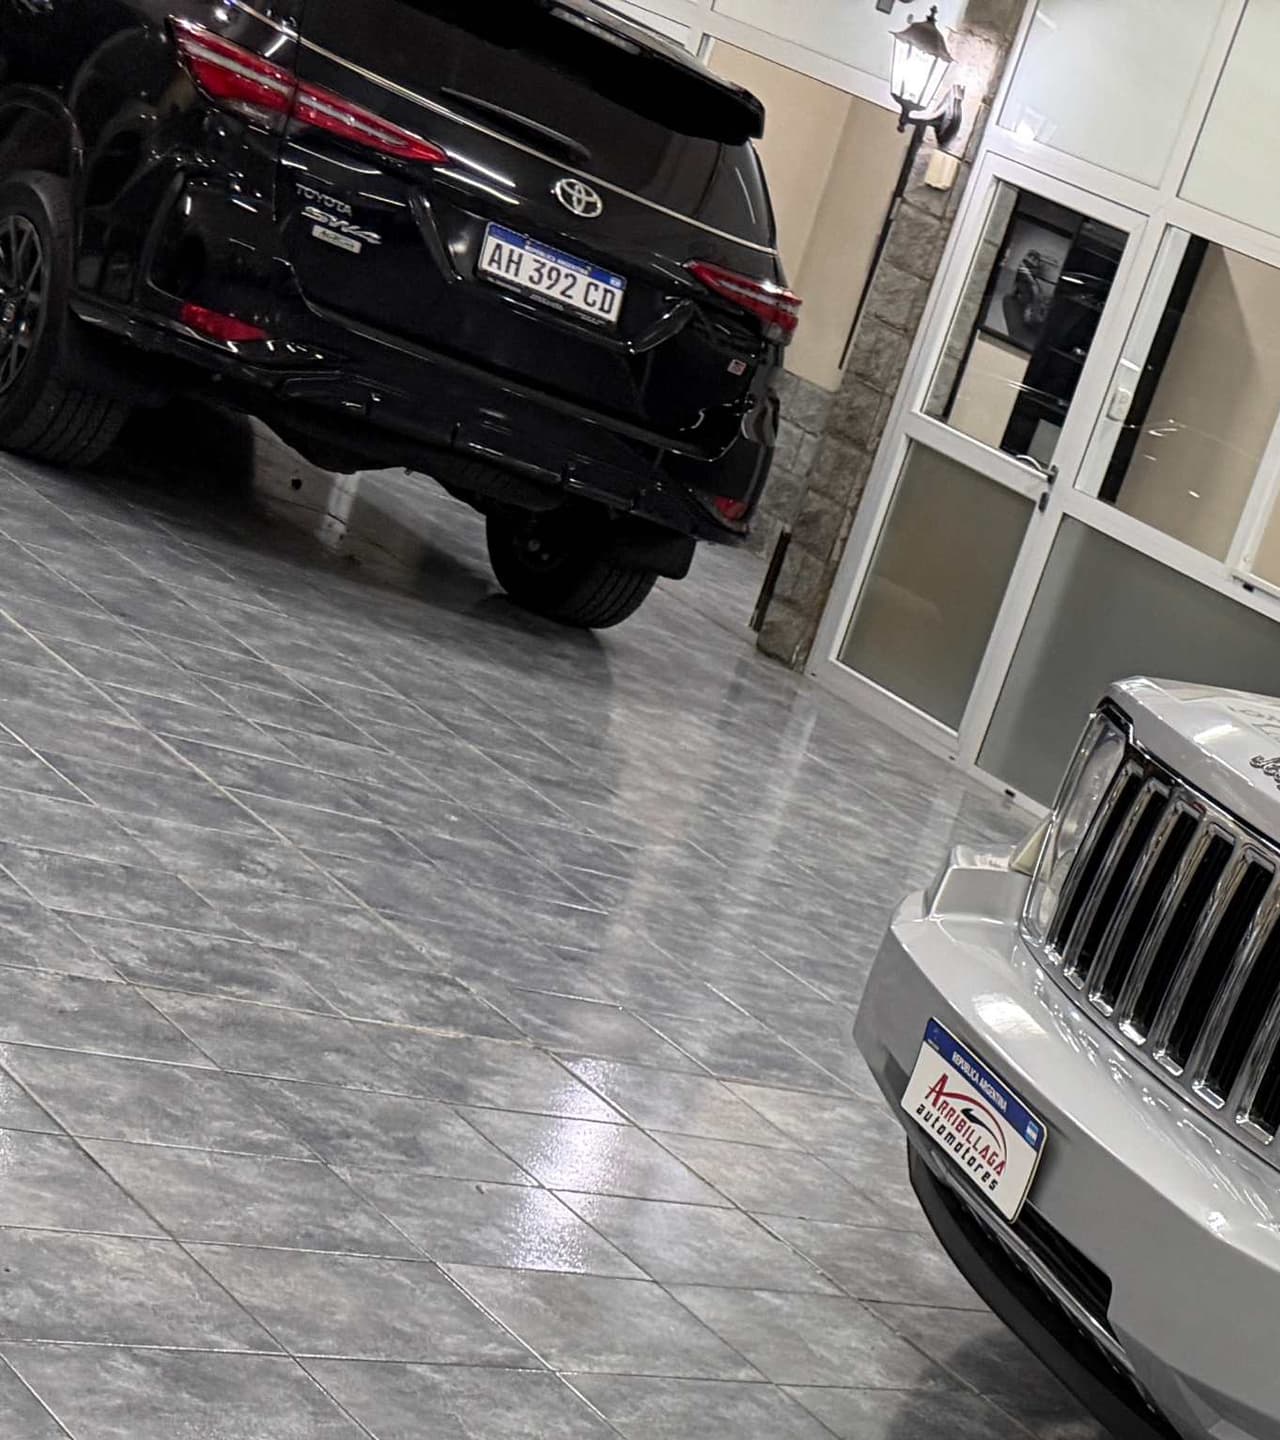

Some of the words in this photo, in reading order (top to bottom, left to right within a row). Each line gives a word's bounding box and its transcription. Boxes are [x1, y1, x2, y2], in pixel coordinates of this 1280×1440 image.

[295, 182, 353, 217] TOYOTA
[487, 242, 524, 278] AH
[528, 258, 578, 300] 392
[583, 281, 617, 315] CD
[925, 1073, 1007, 1177] ARRIBILLAGA
[978, 1075, 1008, 1113] ARGENTINA
[915, 1102, 1000, 1192] automotores
